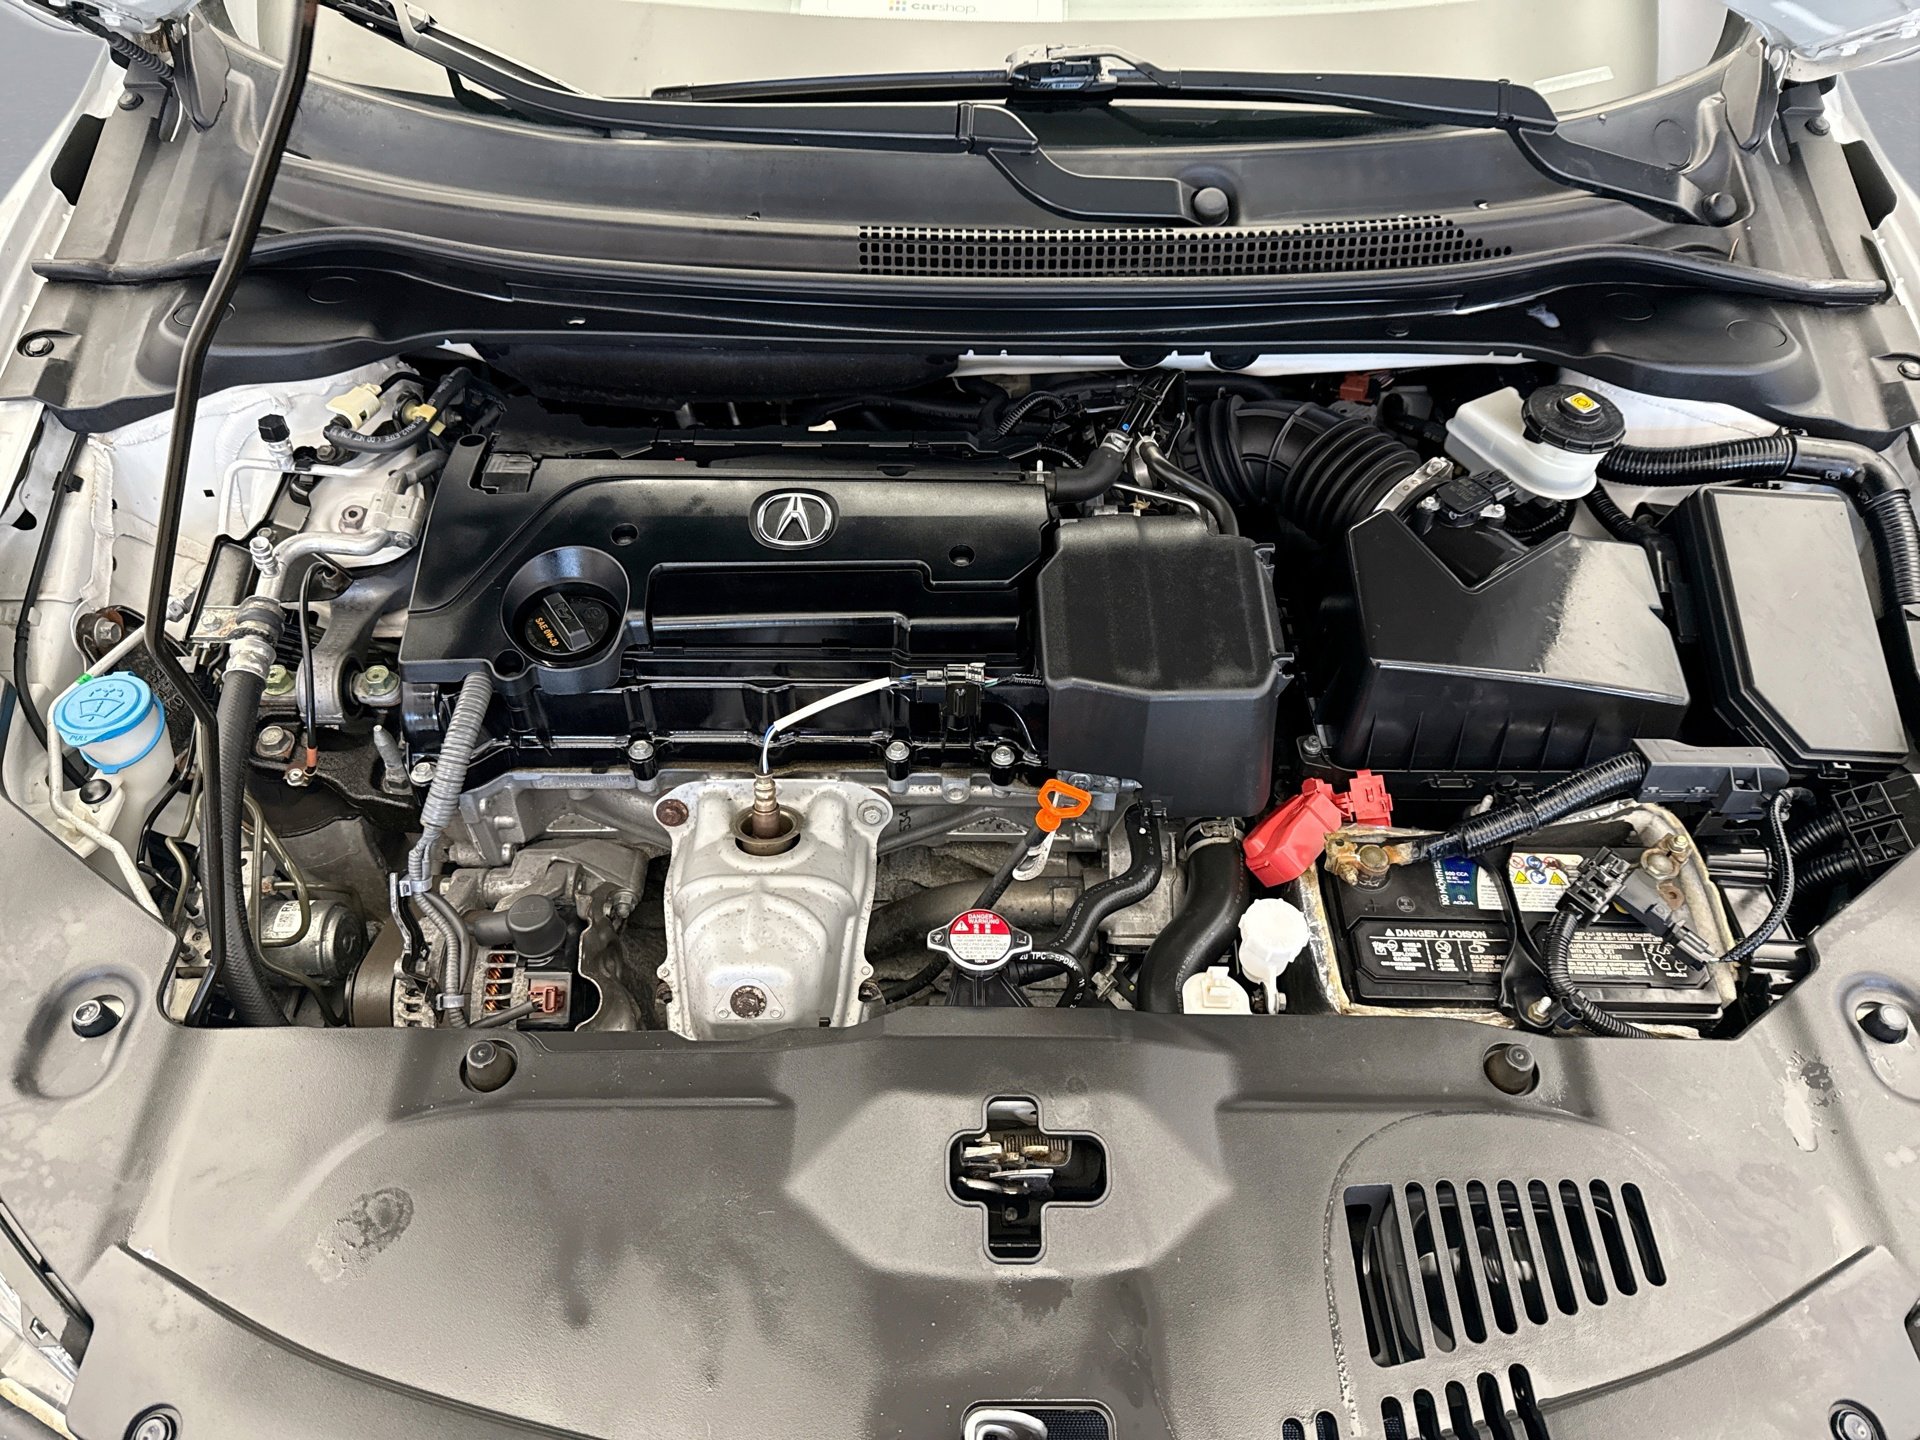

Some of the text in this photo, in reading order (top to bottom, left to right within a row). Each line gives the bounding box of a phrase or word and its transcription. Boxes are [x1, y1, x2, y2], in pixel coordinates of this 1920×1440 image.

[535, 617, 559, 647] SAE 0W-20
[1395, 928, 1439, 938] DANGER
[1448, 930, 1487, 939] POISON
[1031, 951, 1047, 961] TPC
